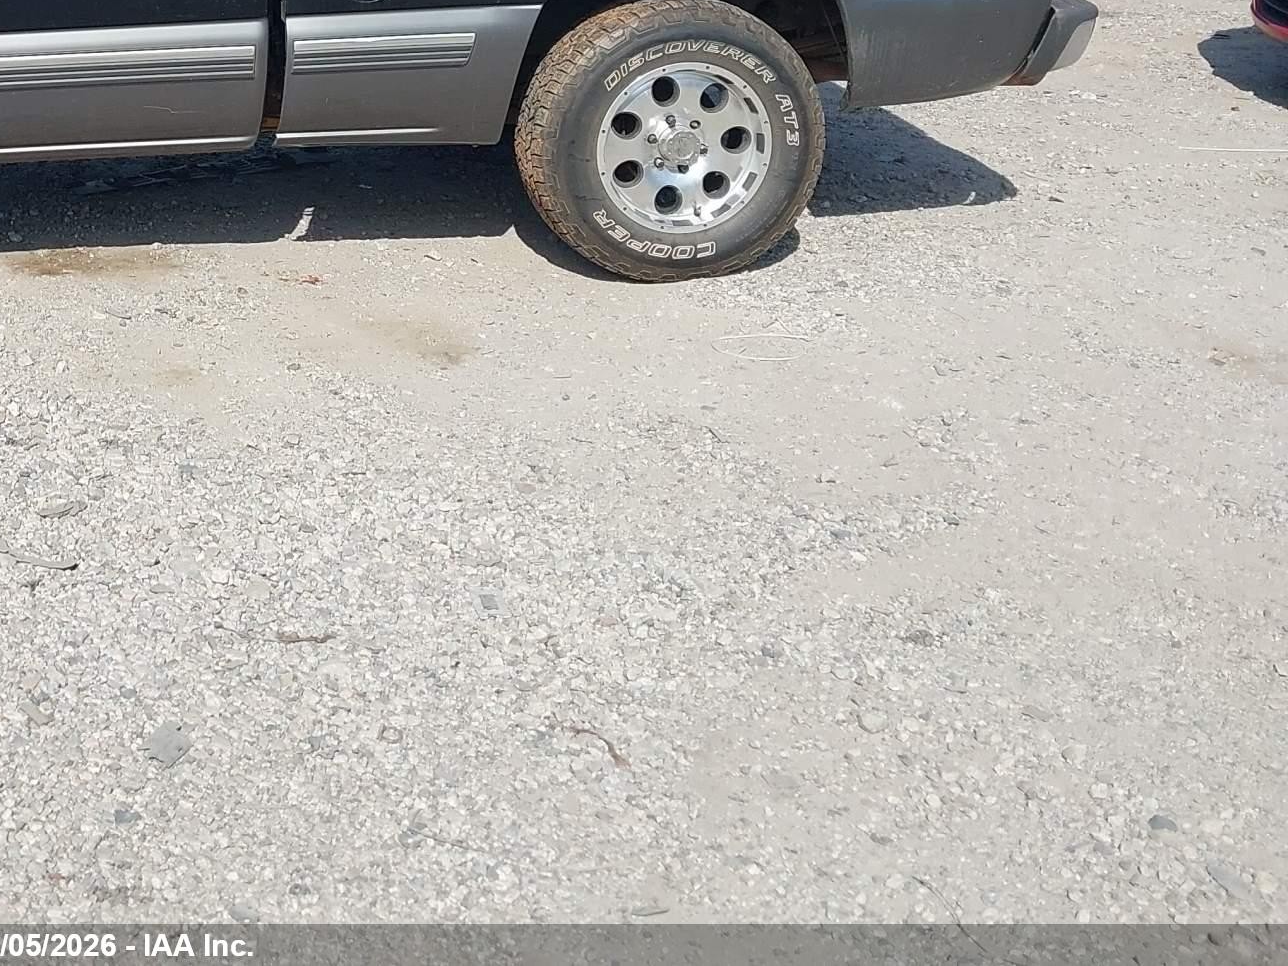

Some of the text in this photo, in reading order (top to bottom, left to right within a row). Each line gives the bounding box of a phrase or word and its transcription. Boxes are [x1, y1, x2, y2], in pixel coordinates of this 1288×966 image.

[603, 40, 801, 147] DISCOVERER AT3
[592, 209, 717, 260] COOPER
